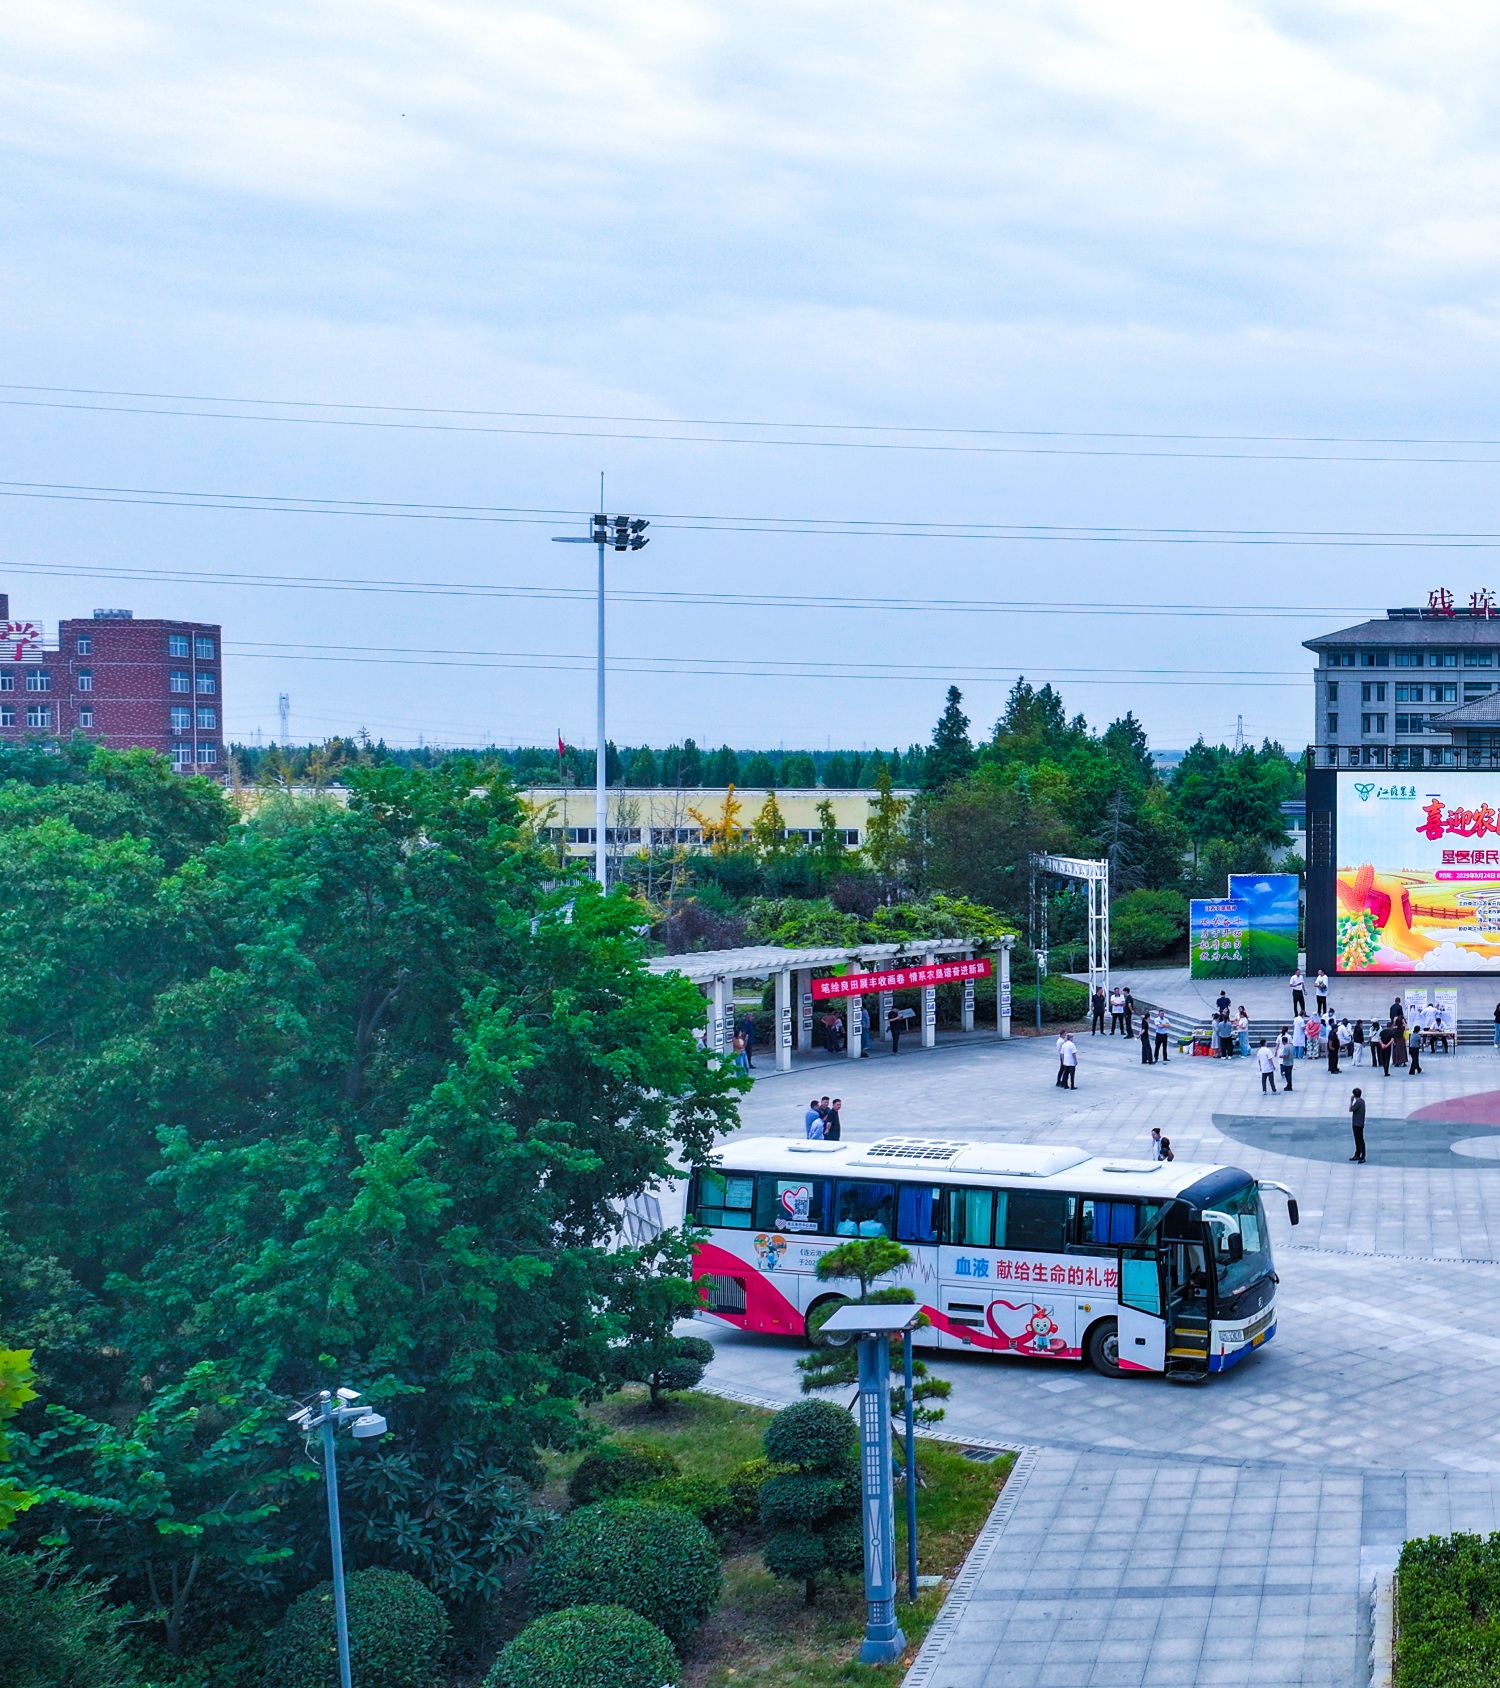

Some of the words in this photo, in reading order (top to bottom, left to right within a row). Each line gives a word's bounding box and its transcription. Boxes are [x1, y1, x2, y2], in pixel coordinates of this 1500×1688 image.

[820, 973, 905, 994] 笔绘良田展丰收画卷
[909, 962, 985, 983] 情系农垦谱奋进新篇
[955, 1256, 990, 1278] 血液
[996, 1259, 1118, 1288] 献给生命的礼物
